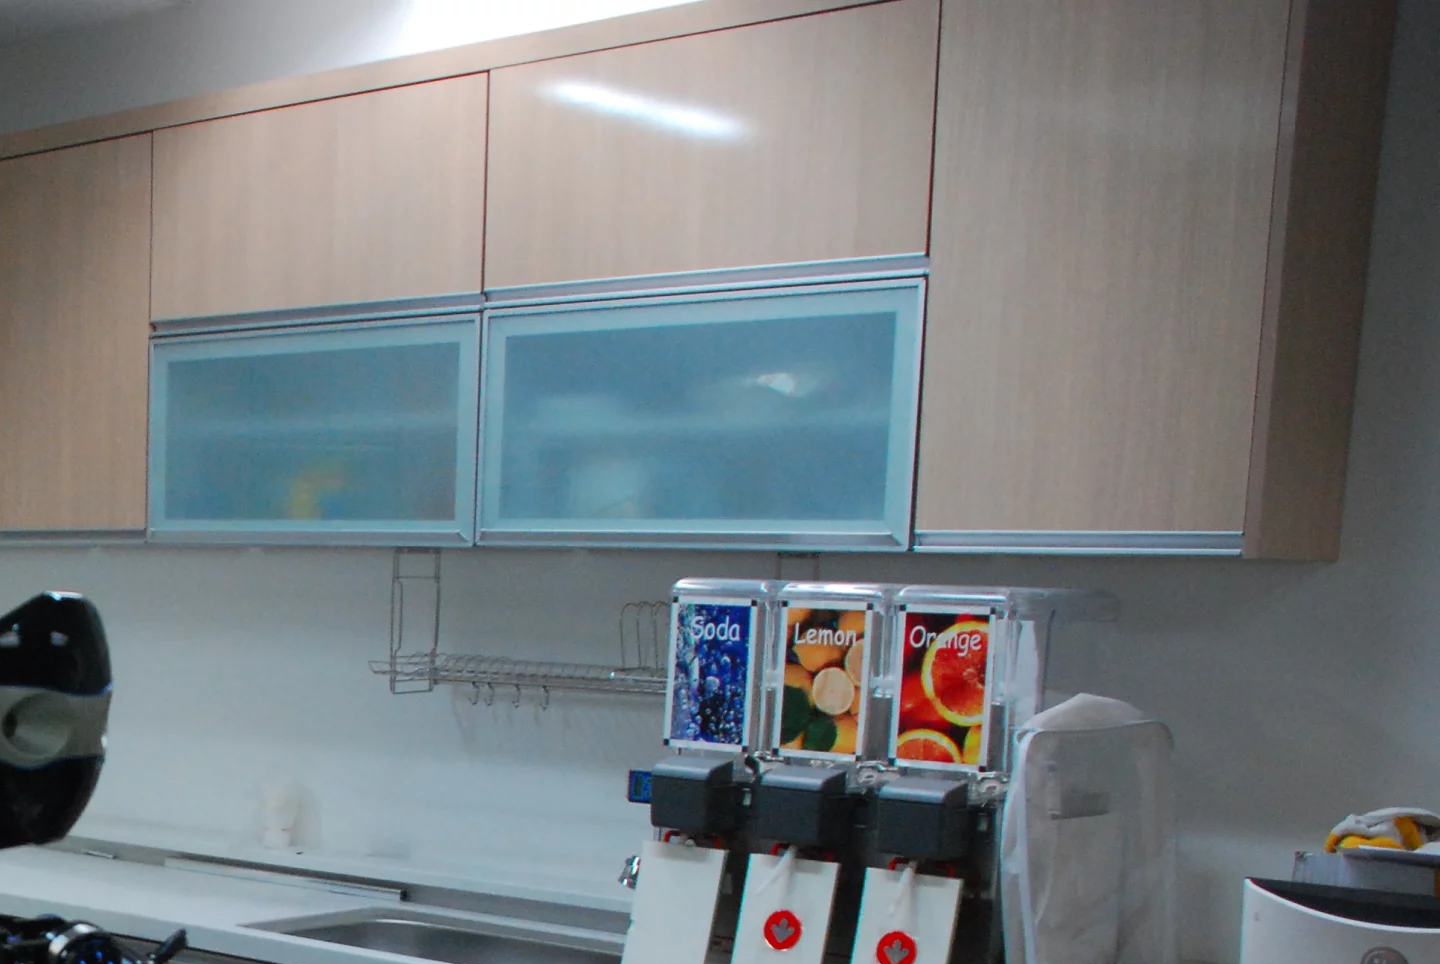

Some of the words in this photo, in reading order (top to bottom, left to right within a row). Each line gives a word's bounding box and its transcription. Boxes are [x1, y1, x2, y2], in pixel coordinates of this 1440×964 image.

[690, 615, 741, 642] Soda
[794, 622, 857, 647] Lemon
[910, 625, 982, 657] Orange
